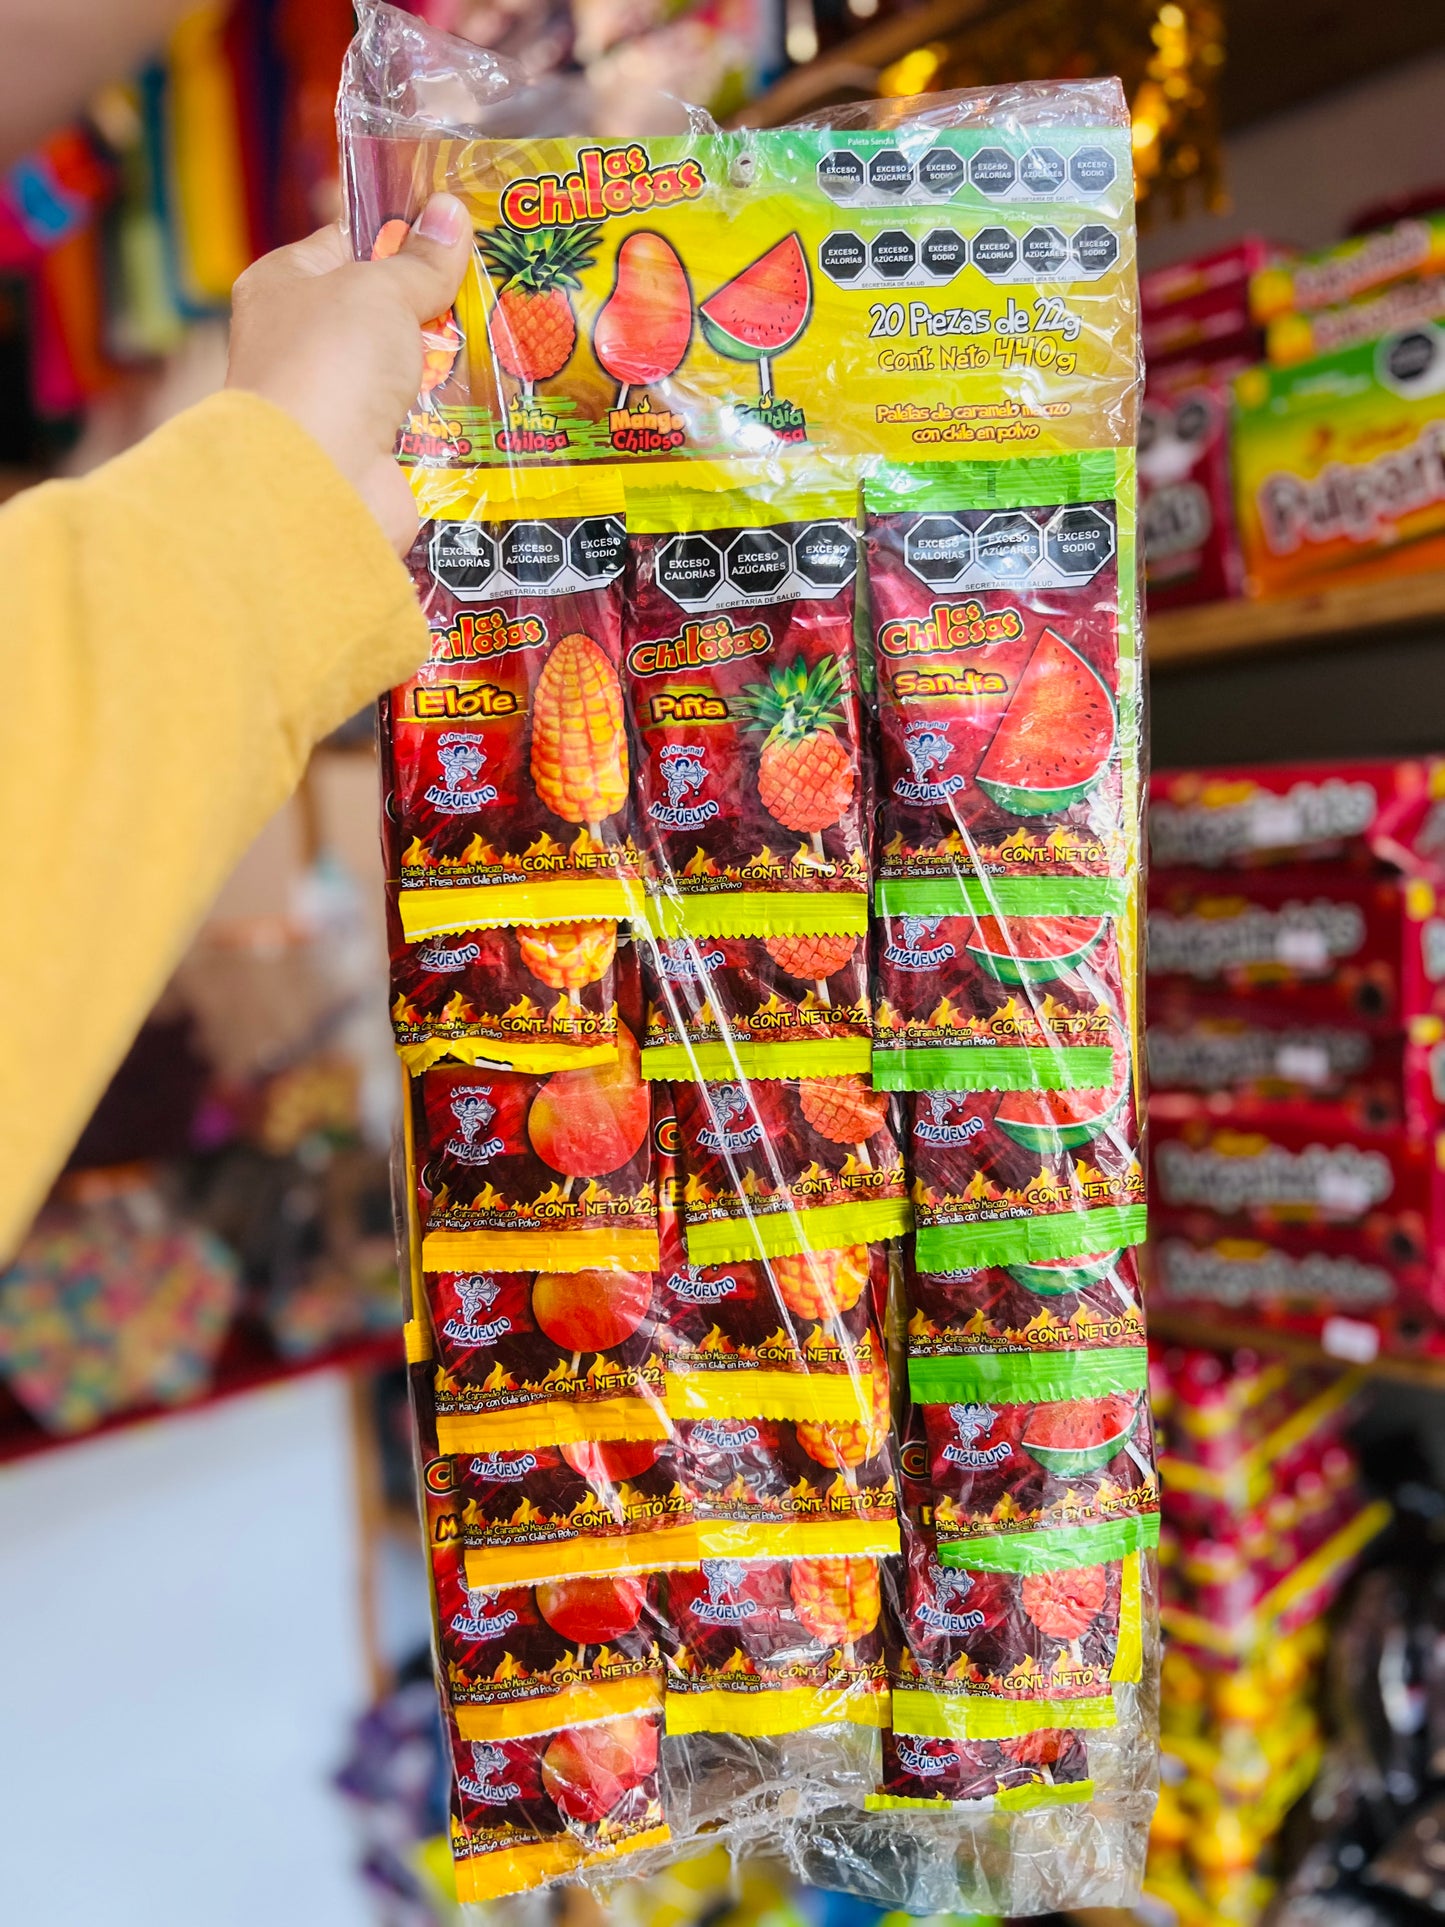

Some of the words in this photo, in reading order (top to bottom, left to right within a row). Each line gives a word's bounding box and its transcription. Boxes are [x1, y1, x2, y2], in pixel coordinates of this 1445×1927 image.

[872, 173, 912, 182] AZÚCARES
[975, 170, 1012, 179] CALORÍAS
[502, 150, 705, 230] Chilosas
[825, 256, 862, 264] CALORÍAS
[874, 253, 914, 263] AZÚCARES
[976, 250, 1014, 260] CALORÍAS
[1083, 248, 1107, 256] SODIO
[869, 303, 905, 338] 20
[910, 302, 990, 336] Piezas
[995, 298, 1029, 335] de
[1034, 297, 1081, 341] 22g
[879, 346, 934, 371] Cont.
[940, 344, 990, 371] Neto
[995, 337, 1077, 375] 440g
[509, 406, 558, 433] Piña
[609, 407, 686, 433] Mango
[876, 404, 930, 423] Paletas
[930, 403, 951, 421] de
[953, 400, 1020, 419] caramelo
[912, 426, 940, 441] con
[943, 424, 975, 441] chile
[977, 425, 995, 440] en
[997, 422, 1040, 442] polvo
[497, 431, 569, 453] Chilosa
[612, 431, 685, 453] Chiloso
[581, 538, 621, 549] EXCESO
[918, 539, 959, 548] EXCESO
[989, 535, 1030, 543] EXCESO
[1057, 530, 1100, 542] EXCESO
[442, 548, 484, 556] EXCESO
[512, 545, 552, 553] EXCESO
[585, 549, 617, 558] SODIO
[806, 545, 847, 554] EXCESO
[913, 550, 965, 560] CALORÍAS
[981, 544, 1036, 557] AZÚCARES
[1062, 543, 1095, 553] SODIO
[438, 557, 490, 568] CALORÍAS
[506, 555, 560, 565] AZÚCARES
[669, 559, 710, 568] EXCESO
[738, 552, 778, 562] EXCESO
[664, 569, 715, 580] CALORÍAS
[731, 562, 786, 575] AZÚCARES
[490, 588, 536, 598] SECRETARÍA
[551, 586, 576, 594] SALUD
[716, 599, 762, 608] SECRETARÍA
[776, 592, 800, 601] SALUD
[431, 616, 542, 659] hilosas
[882, 607, 1020, 655] Chilosas
[631, 626, 767, 673] Chilosas
[895, 673, 1005, 693] Sandía
[417, 687, 515, 716] Elote
[653, 696, 726, 721] Piña
[914, 722, 948, 732] Original
[447, 733, 482, 743] Original
[662, 748, 669, 756] el
[670, 746, 703, 755] Original
[425, 785, 496, 806] MIGUELITO
[894, 776, 964, 799] MIGUELITO
[651, 802, 718, 824] MIGUELITO
[522, 857, 571, 871] CONT.
[575, 853, 619, 869] NETO
[1002, 847, 1050, 862] CONT.
[1054, 847, 1100, 861] NETO
[438, 864, 475, 875] Caramelo
[476, 862, 504, 873] Macizo
[740, 866, 788, 880] CONT.
[792, 863, 835, 878] NETO
[842, 864, 867, 882] 22g
[880, 867, 903, 876] Sabor
[936, 866, 950, 874] con
[401, 876, 426, 888] Sabor
[429, 877, 452, 886] Fresa
[456, 877, 470, 885] con
[472, 875, 490, 885] Chile
[503, 874, 526, 883] Polvo
[721, 881, 742, 889] Polvo
[885, 943, 954, 966] MIGUELITO
[501, 1020, 547, 1033] CONT.
[553, 1020, 595, 1033] NETO
[750, 1012, 797, 1029] CONT.
[800, 1011, 842, 1026] NETO
[974, 1036, 996, 1046] Polvo
[915, 1118, 984, 1141] MIGUELITO
[448, 1138, 505, 1160] MIGUELITO
[792, 1182, 837, 1196] CONT.
[841, 1173, 884, 1188] NETO
[1028, 1187, 1074, 1204] CONT.
[535, 1203, 581, 1218] CONT.
[586, 1201, 628, 1215] NETO
[633, 1200, 657, 1216] 22g
[1011, 1207, 1033, 1217] Polvo
[446, 1218, 470, 1230] Mango
[519, 1218, 540, 1227] Polvo
[668, 1274, 736, 1297] MIGUELITO
[444, 1317, 511, 1340] MIGUELITO
[1028, 1329, 1075, 1343] CONT.
[1078, 1323, 1122, 1340] NETO
[808, 1347, 848, 1361] NETO
[738, 1361, 759, 1369] Polvo
[545, 1379, 592, 1394] CONT.
[596, 1373, 638, 1389] NETO
[485, 1399, 500, 1408] con
[501, 1395, 518, 1406] Chile
[520, 1394, 529, 1402] en
[691, 1425, 758, 1447] MIGUELITO
[944, 1442, 1011, 1465] MIGUELITO
[471, 1454, 536, 1476] MIGUELITO
[668, 1496, 693, 1513] 22g
[781, 1499, 826, 1513] CONT.
[831, 1496, 872, 1512] NETO
[1100, 1496, 1139, 1515] NETO
[464, 1535, 484, 1546] Sabor
[514, 1534, 527, 1542] con
[529, 1531, 546, 1542] Chile
[548, 1531, 557, 1539] en
[558, 1529, 579, 1539] Polvo
[691, 1600, 757, 1619] MIGUELITO
[916, 1603, 984, 1630] MIGUELITO
[452, 1610, 517, 1634] MIGUELITO
[553, 1670, 598, 1683] CONT.
[602, 1663, 643, 1678] NETO
[1004, 1676, 1049, 1689] CONT.
[1053, 1670, 1094, 1684] NETO
[897, 1745, 960, 1768] MIGUELITO
[460, 1777, 520, 1799] MIGUELITO
[500, 1837, 513, 1846] con
